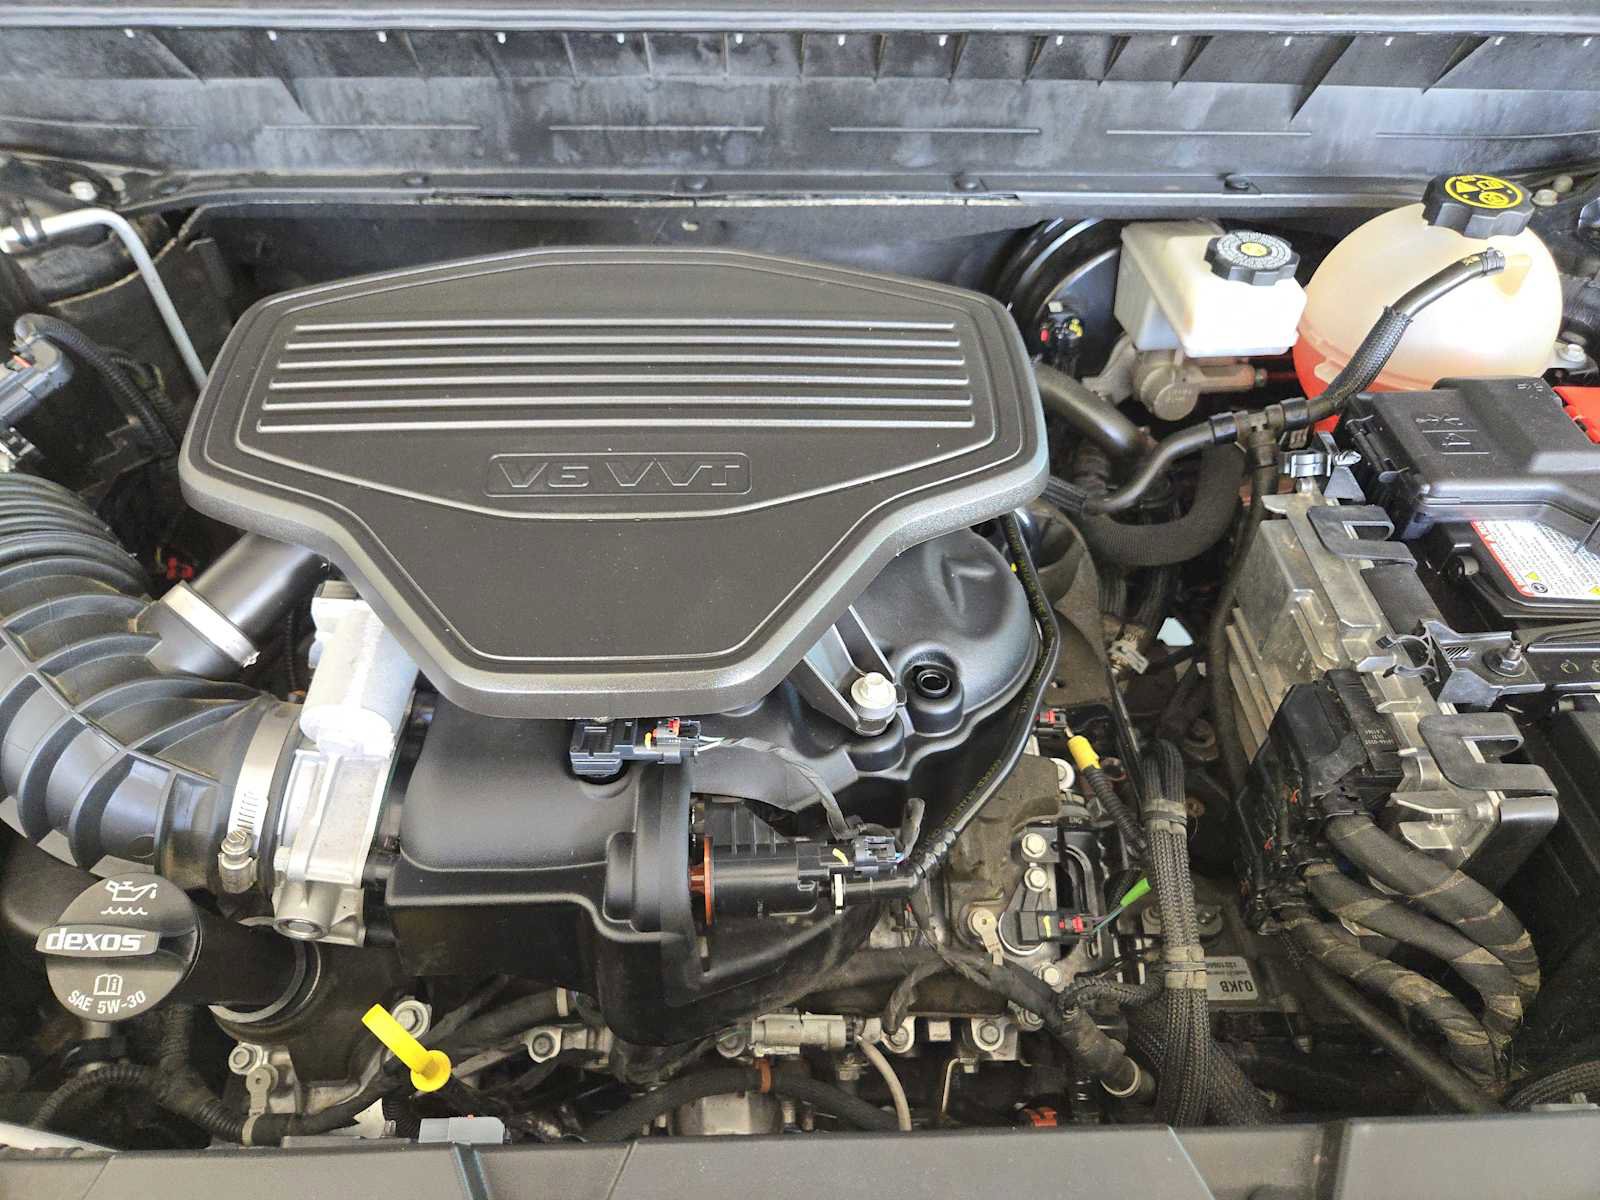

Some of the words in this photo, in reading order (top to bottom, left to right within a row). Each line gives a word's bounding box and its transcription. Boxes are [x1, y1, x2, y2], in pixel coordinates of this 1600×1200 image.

[499, 460, 590, 488] V6
[605, 459, 741, 487] VVT
[46, 929, 142, 951] dexos
[68, 990, 94, 1011] SAE
[97, 990, 146, 1014] 5W-30
